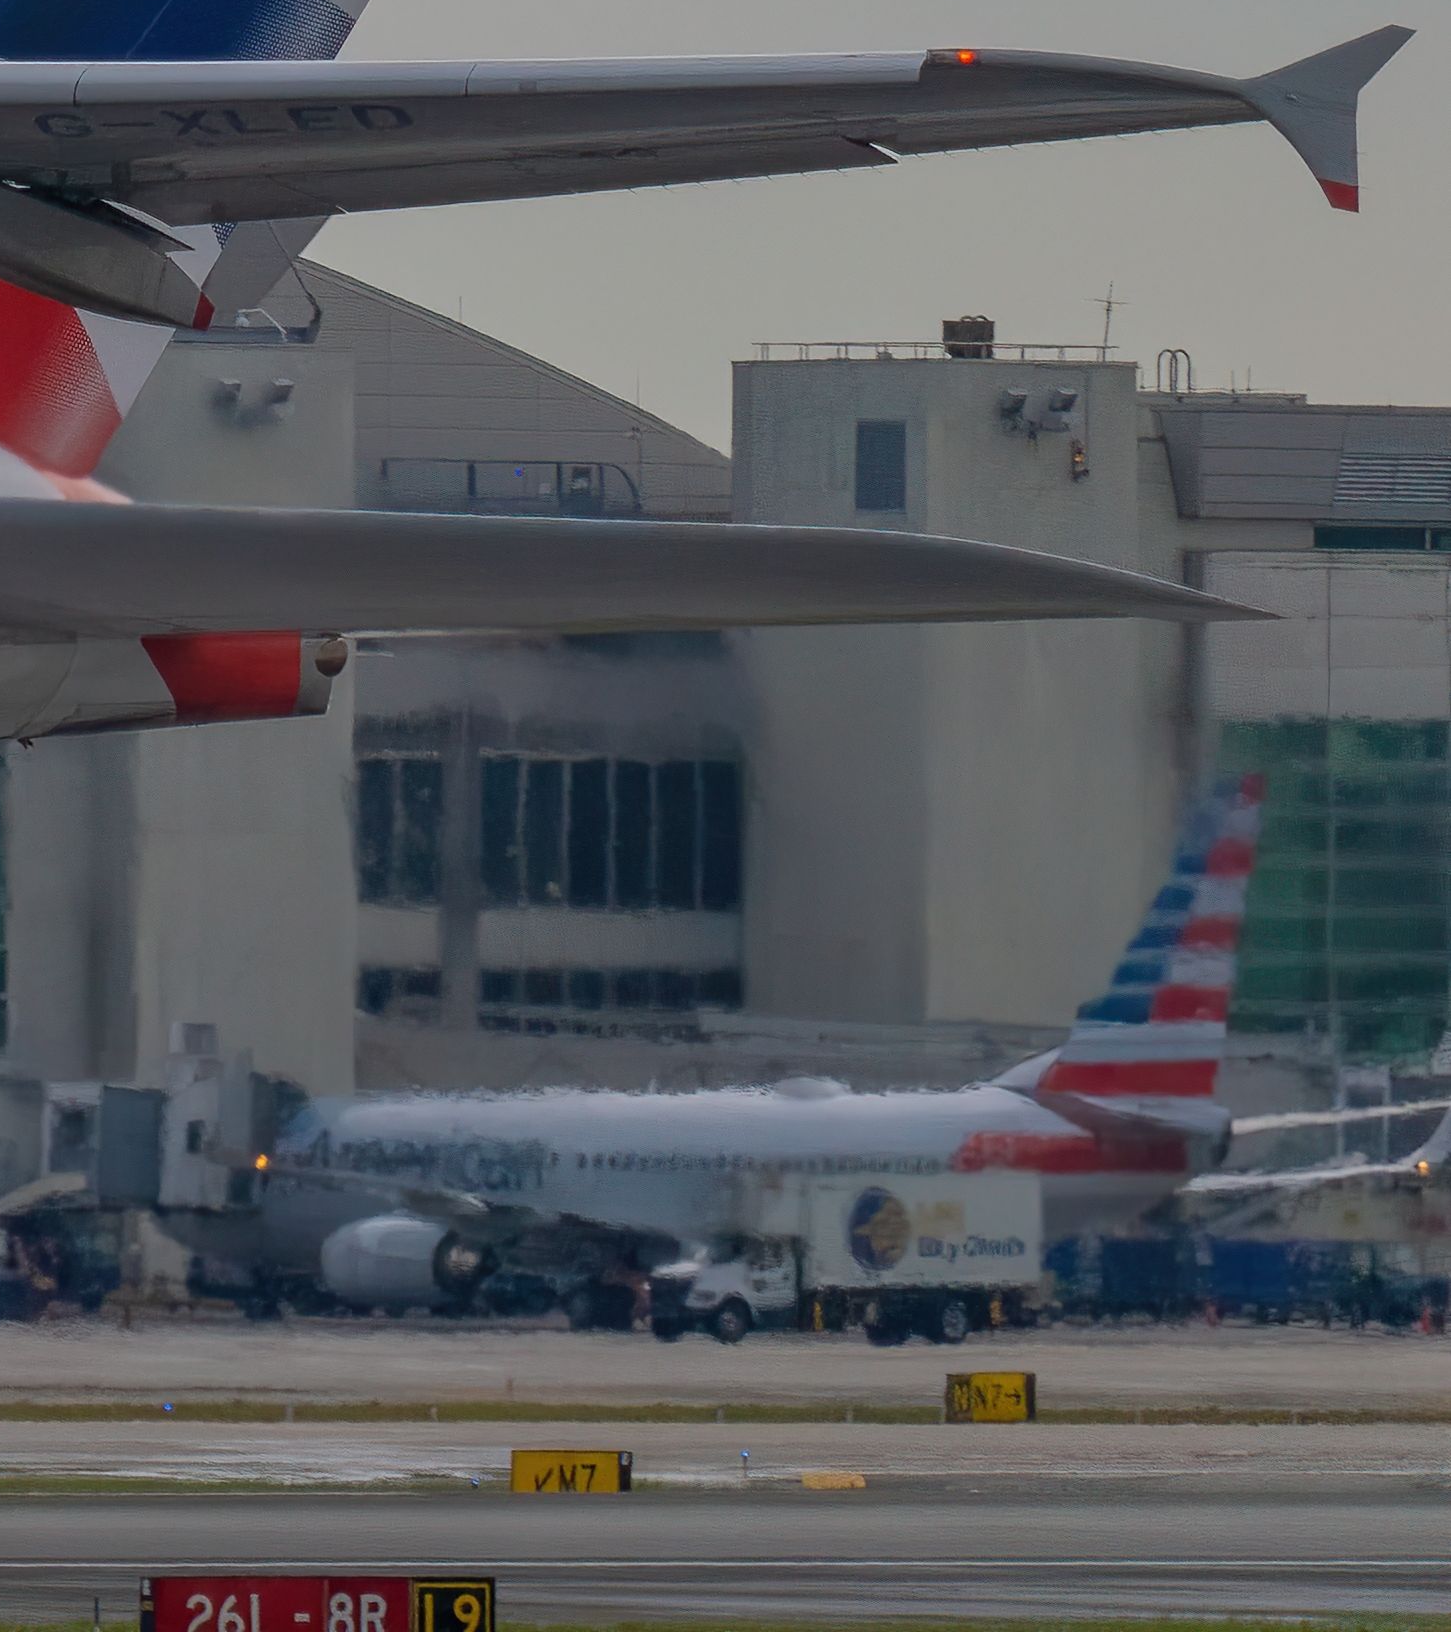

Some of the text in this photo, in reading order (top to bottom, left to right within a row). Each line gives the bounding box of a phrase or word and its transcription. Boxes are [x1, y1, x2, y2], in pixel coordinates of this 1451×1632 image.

[34, 104, 415, 138] G-XLED
[308, 1128, 544, 1191] Acan
[559, 1464, 597, 1492] M7
[328, 1593, 388, 1632] 8R
